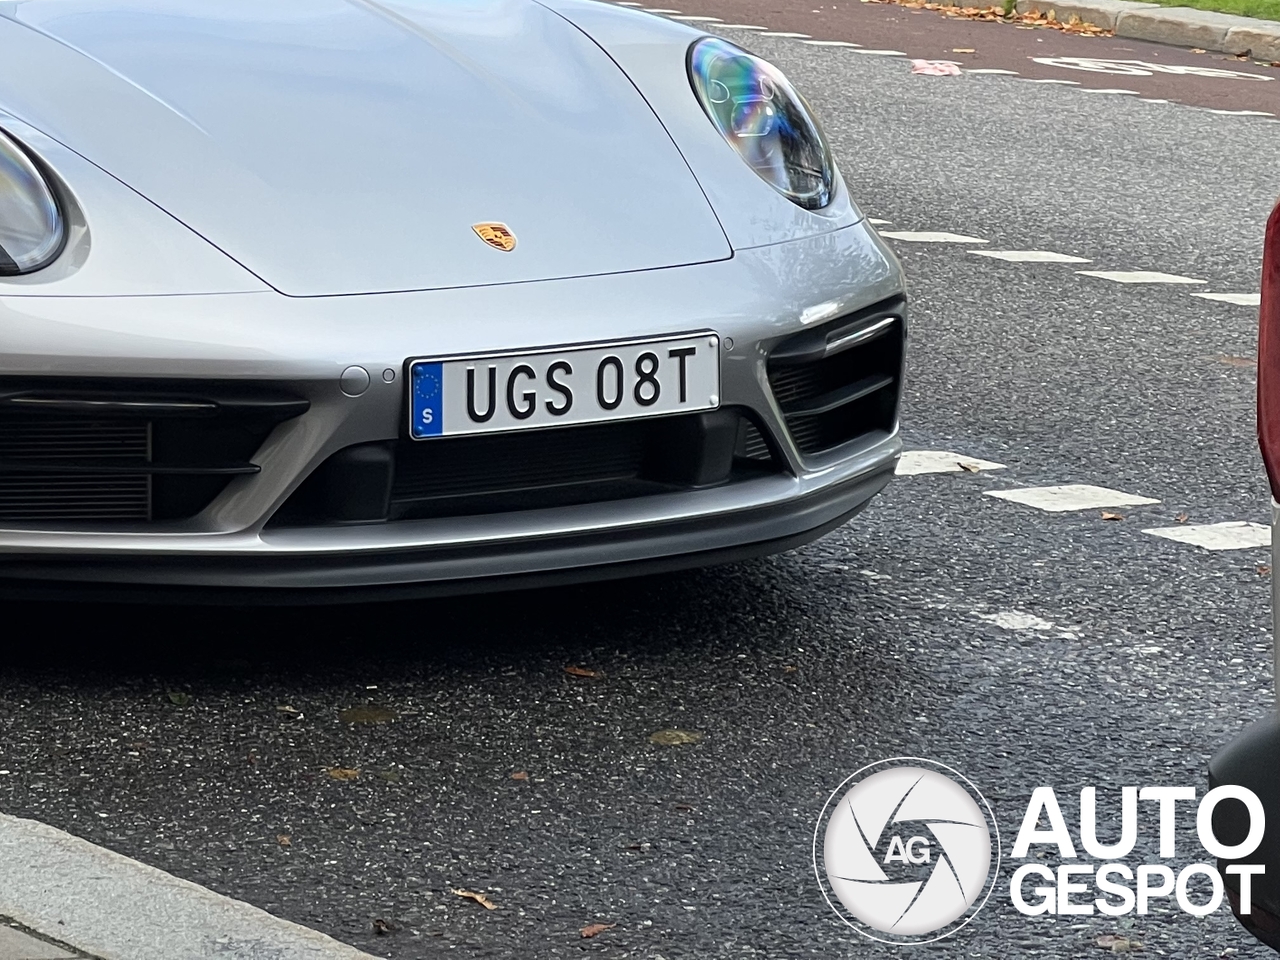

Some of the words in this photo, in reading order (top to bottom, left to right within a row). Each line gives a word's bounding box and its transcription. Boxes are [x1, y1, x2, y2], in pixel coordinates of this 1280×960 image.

[421, 407, 434, 425] S
[466, 360, 574, 424] UGS
[596, 346, 697, 411] 08T
